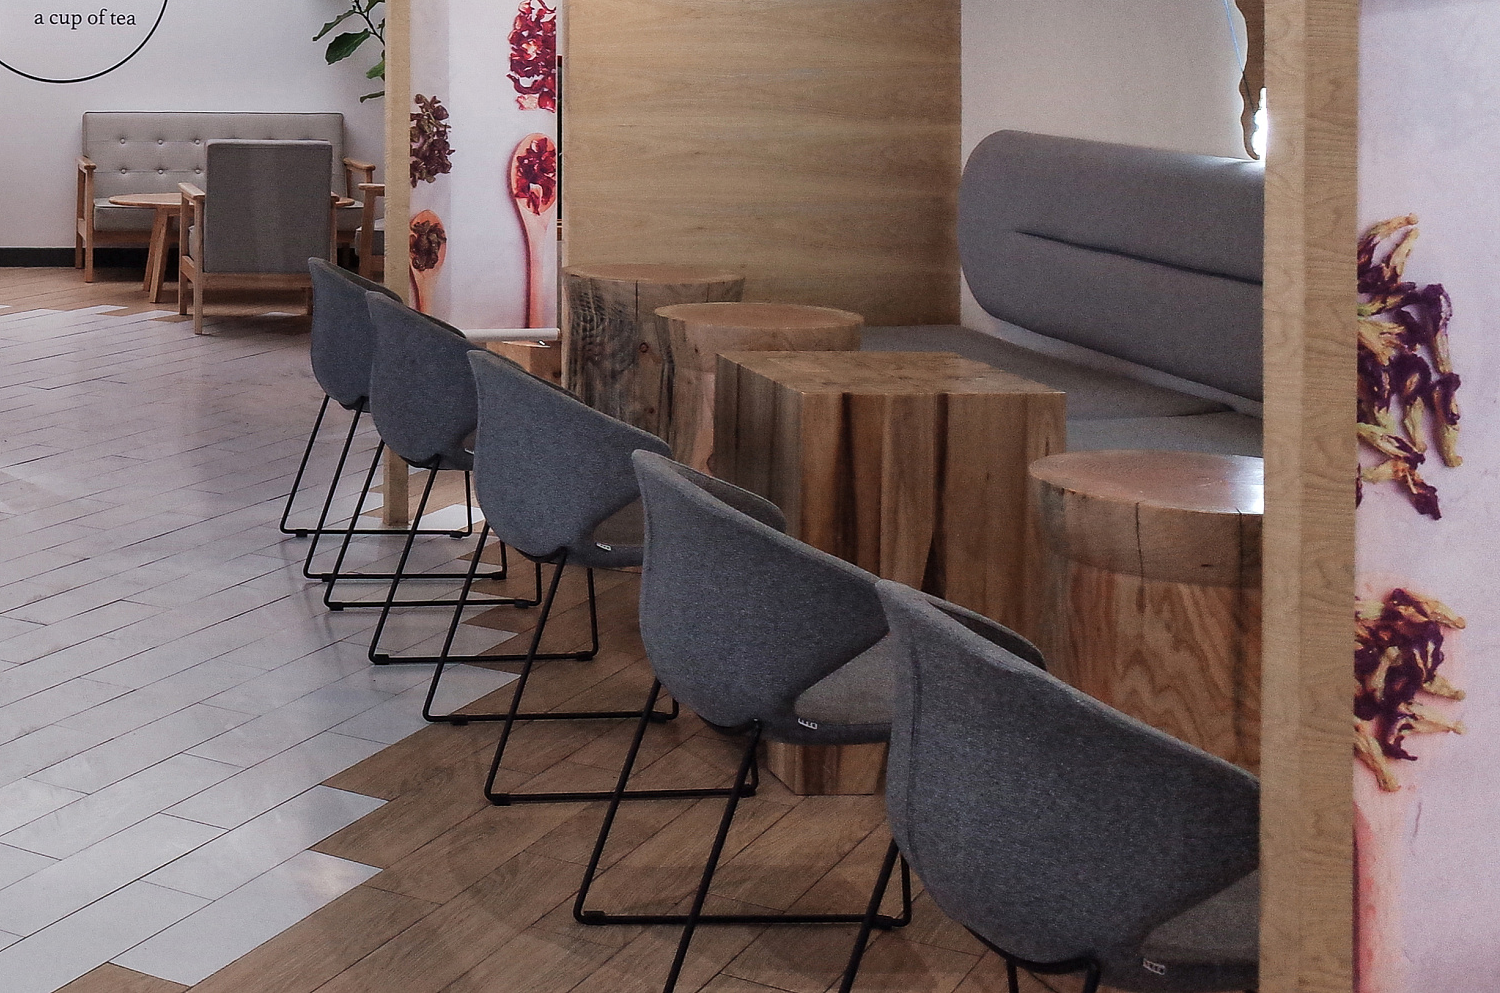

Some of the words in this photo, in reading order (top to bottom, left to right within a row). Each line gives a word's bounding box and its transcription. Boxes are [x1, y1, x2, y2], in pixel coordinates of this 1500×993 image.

[34, 13, 45, 25] a
[49, 13, 82, 30] cup
[87, 8, 108, 25] of
[110, 12, 136, 26] tea
